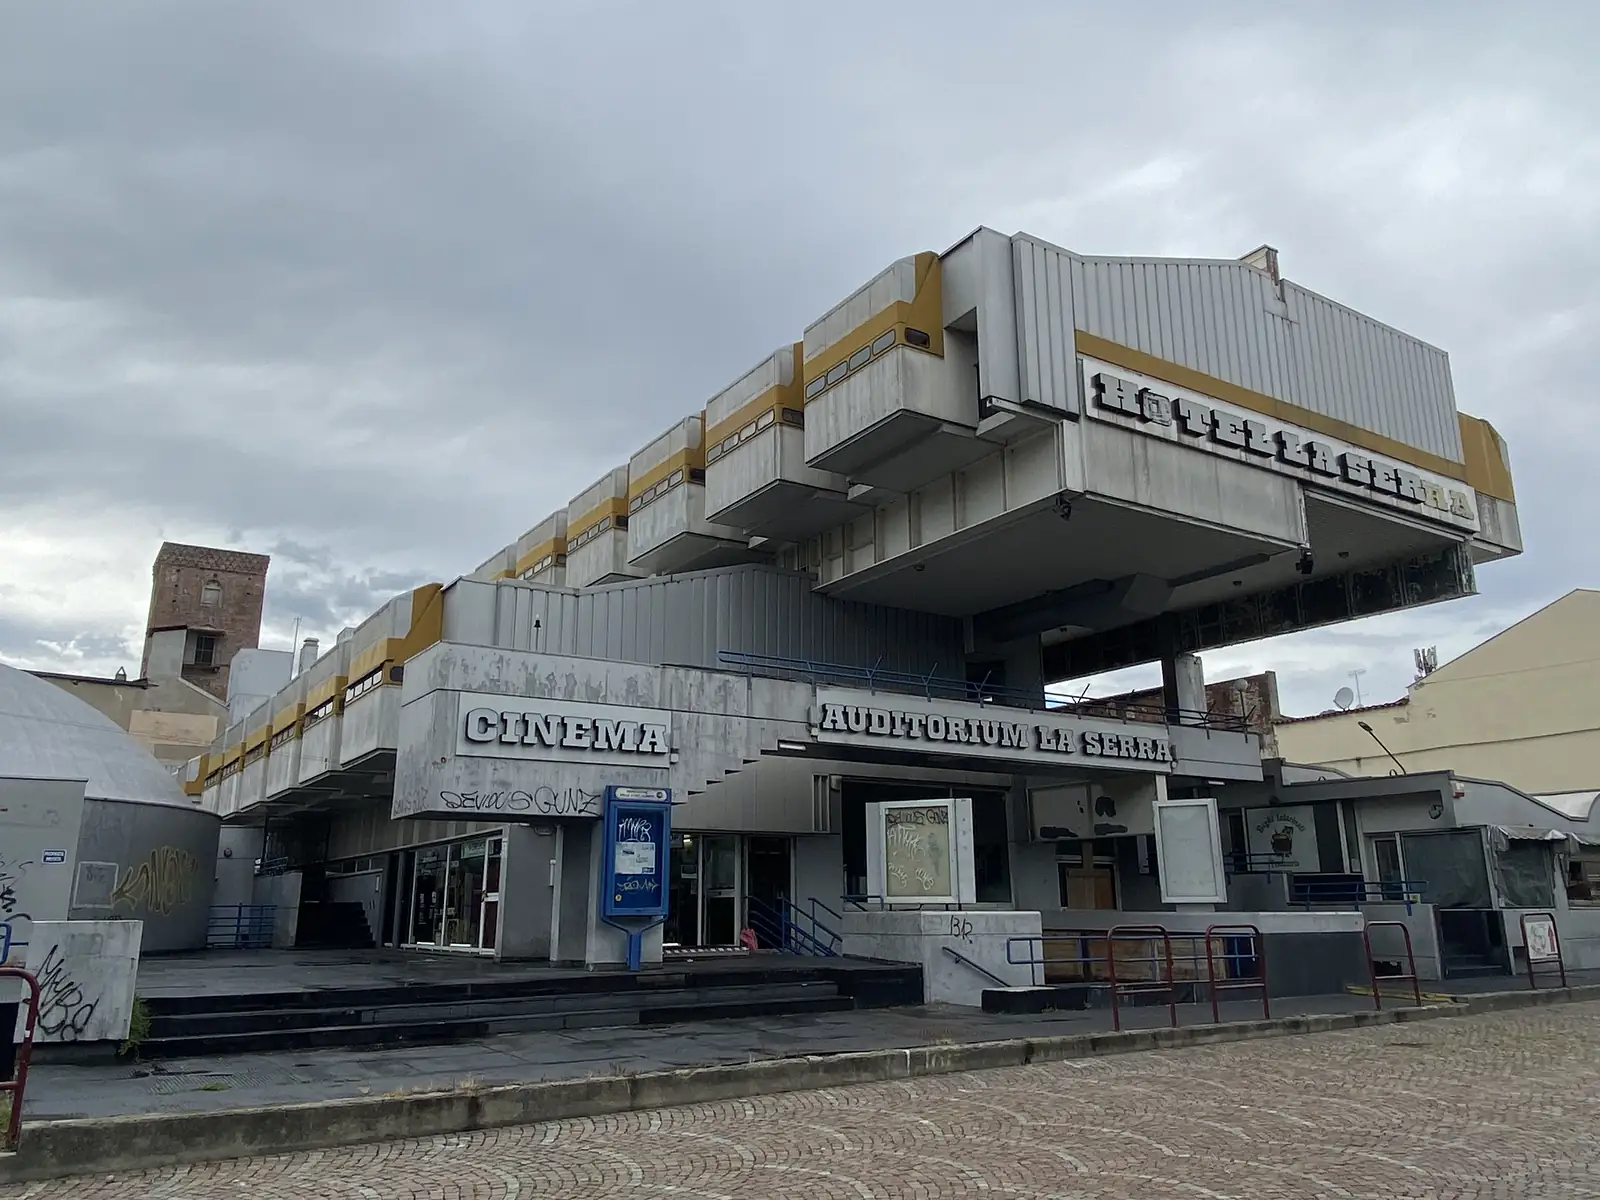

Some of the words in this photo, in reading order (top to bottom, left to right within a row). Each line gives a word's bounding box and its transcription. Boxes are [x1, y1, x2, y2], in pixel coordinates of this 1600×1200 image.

[1274, 430, 1341, 477] LA
[1339, 451, 1475, 521] SERRA
[466, 707, 669, 754] CINEMA
[821, 703, 1030, 749] AUDITORIUM
[1035, 724, 1078, 752] LA
[1083, 731, 1175, 762] SERRA
